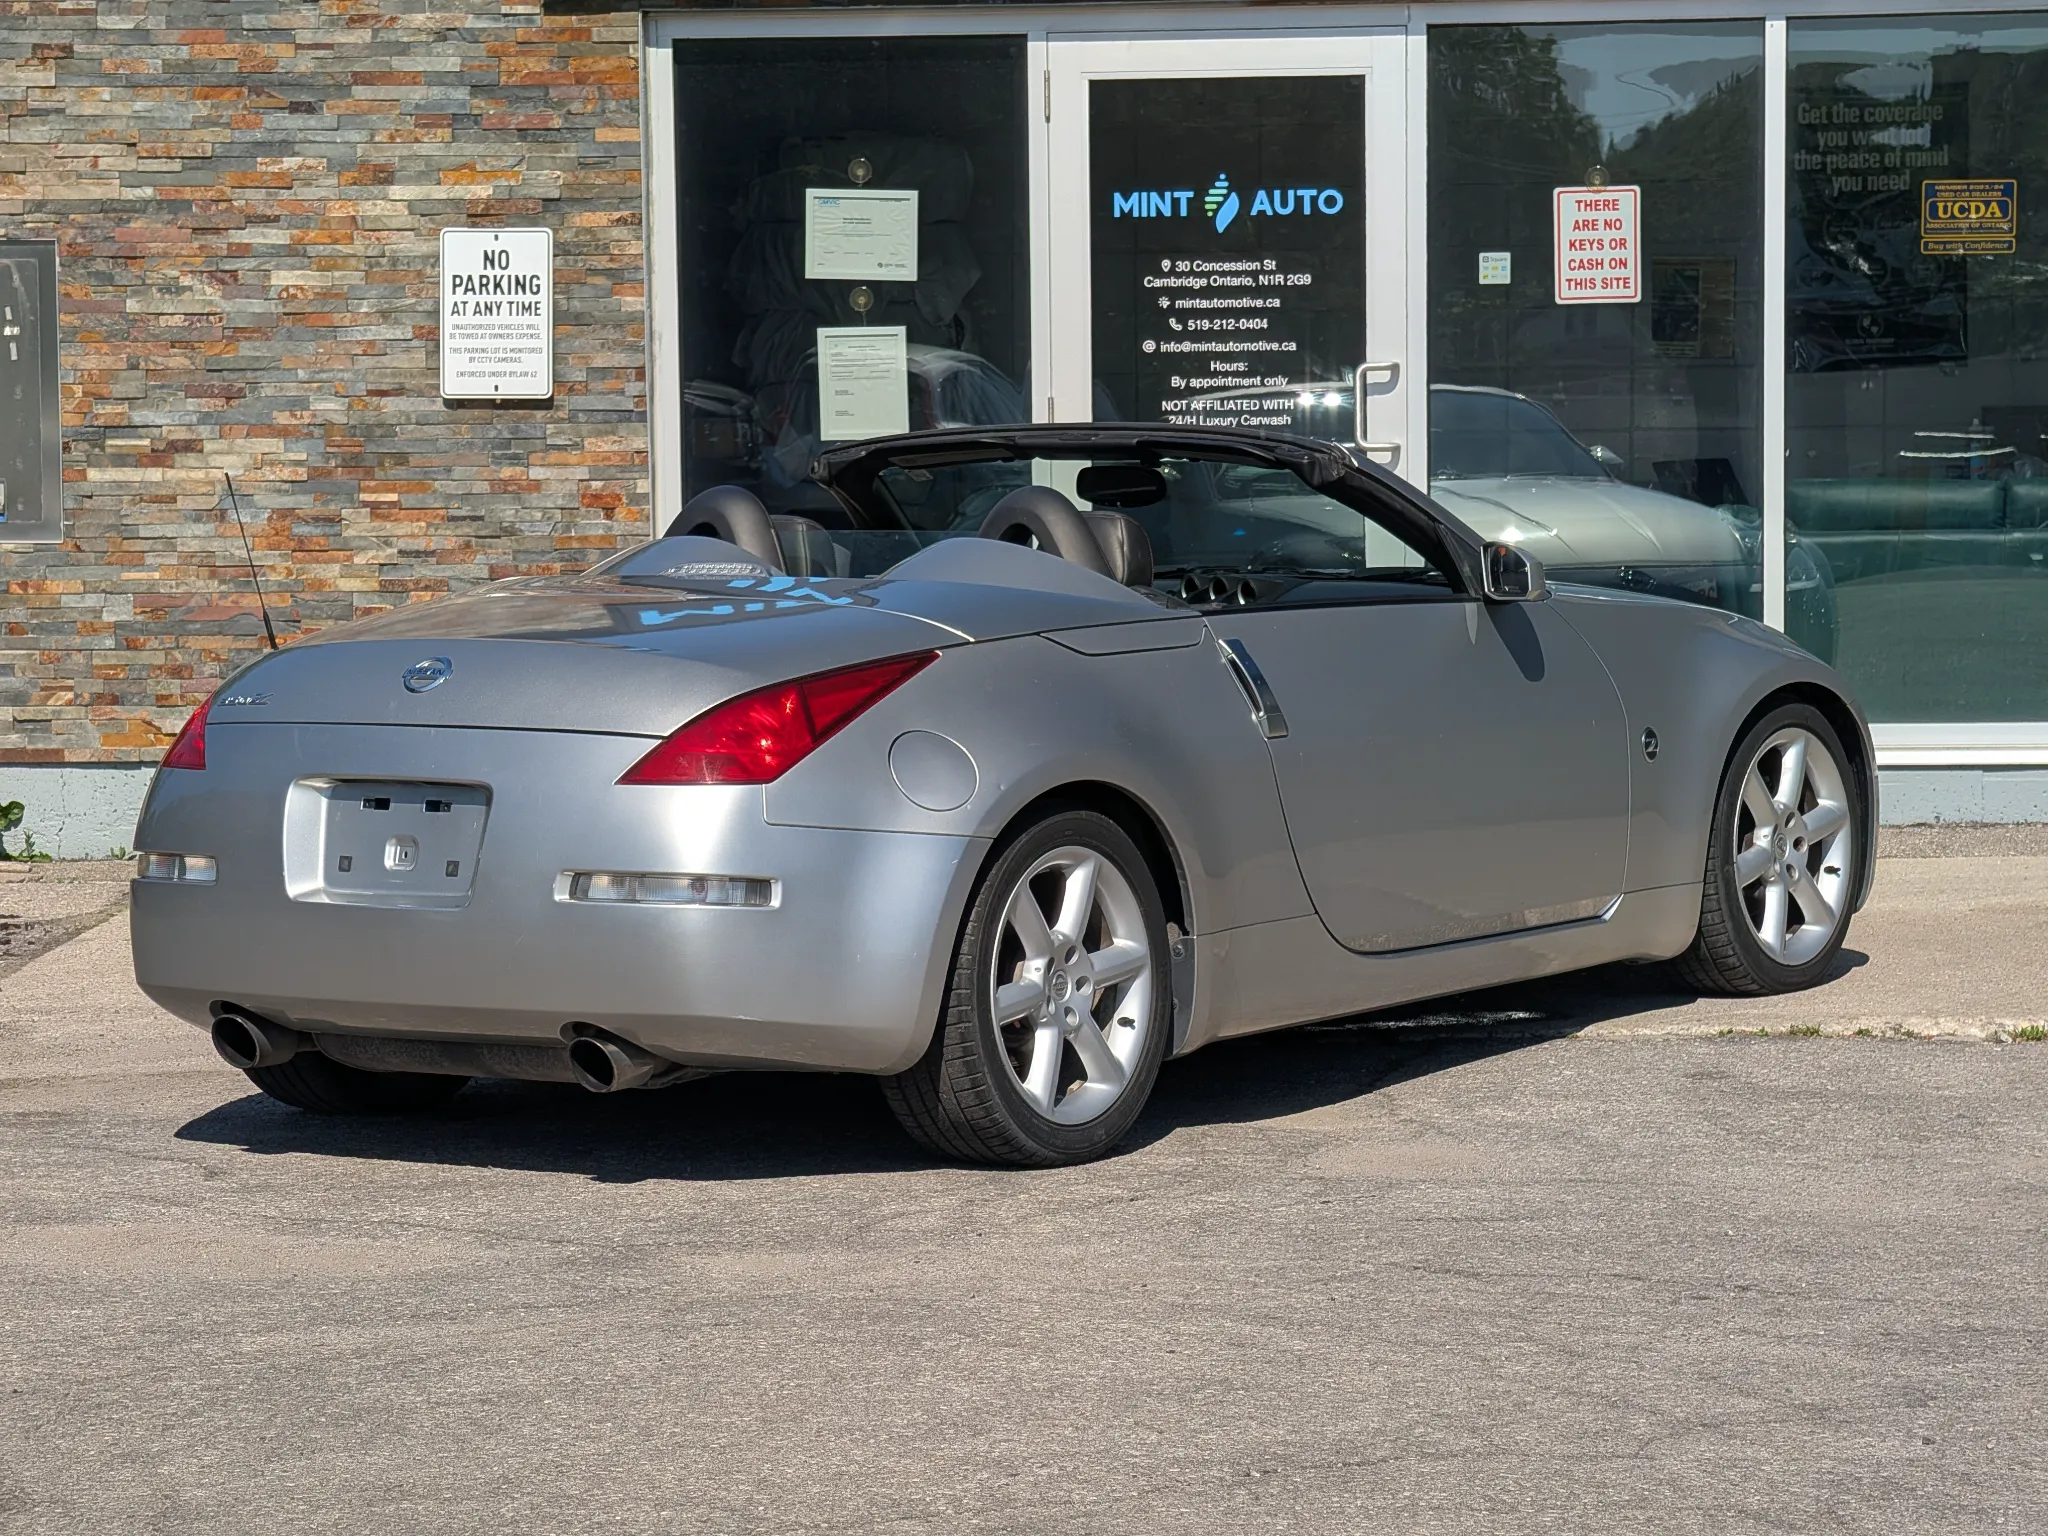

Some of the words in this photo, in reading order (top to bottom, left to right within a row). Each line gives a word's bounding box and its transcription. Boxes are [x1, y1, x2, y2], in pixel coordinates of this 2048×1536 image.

[1798, 102, 1828, 124] Get
[1831, 102, 1860, 123] the
[1864, 104, 1943, 126] coverage
[1817, 131, 1848, 152] you
[1794, 149, 1822, 170] the
[1826, 153, 1880, 174] peace
[1884, 151, 1902, 168] of
[1905, 144, 1949, 167] mind
[1831, 175, 1862, 197] you
[1867, 169, 1910, 191] need
[1113, 191, 1194, 218] MINT
[1250, 189, 1343, 216] AUTO
[1575, 199, 1620, 212] THERE
[1936, 201, 2003, 218] UCDA
[1572, 219, 1599, 232] ARE
[1603, 218, 1623, 231] NO
[1569, 238, 1604, 251] KEYS
[1609, 238, 1628, 251] OR
[1927, 242, 1944, 250] Buy
[1965, 241, 2009, 250] Confidence
[483, 249, 510, 271] NO
[1175, 261, 1190, 272] 30
[1193, 260, 1261, 272] Concession
[1263, 259, 1277, 271] St
[1568, 258, 1604, 271] CASH
[1608, 258, 1628, 270] ON
[451, 274, 541, 296] PARKING
[1143, 276, 1208, 289] Cambridge
[1210, 274, 1256, 287] Ontario,
[1258, 274, 1285, 286] N1R
[1287, 274, 1312, 286] 2G9
[1565, 278, 1596, 291] THIS
[1601, 277, 1631, 290] SITE
[450, 301, 468, 317] AT
[472, 301, 504, 317] ANY
[507, 301, 542, 317] TIME
[1175, 297, 1281, 309] mintautomotive.ca
[451, 323, 496, 331] UNAUTHORIZED
[497, 323, 525, 331] VEHICLES
[526, 323, 540, 331] WILL
[1187, 318, 1268, 330] 519-212-0404
[449, 332, 457, 340] BE
[458, 332, 479, 340] TOWED
[480, 332, 487, 340] AT
[488, 332, 514, 340] OWNERS
[449, 347, 462, 355] THIS
[463, 347, 489, 355] PARKING
[490, 347, 501, 355] LOT
[502, 347, 508, 355] IS
[509, 347, 543, 355] MONITORED
[1160, 341, 1297, 353] info@mintautomotive.ca
[468, 356, 476, 364] BY
[476, 356, 493, 364] CCTV
[1210, 360, 1249, 372] Hours:
[456, 370, 486, 378] ENFORCED
[488, 370, 507, 378] UNDER
[508, 370, 529, 378] BYLAW
[530, 370, 538, 378] 62
[1171, 376, 1186, 389] By
[1189, 375, 1261, 389] appointment
[1264, 374, 1289, 388] only
[1161, 400, 1189, 412] NOT
[1190, 399, 1260, 411] AFFILIATED
[1262, 399, 1294, 410] WITH
[1168, 416, 1196, 425] 24/H
[1199, 415, 1239, 428] Luxury
[1241, 414, 1292, 426] Carwash
[406, 667, 446, 677] NISSAN
